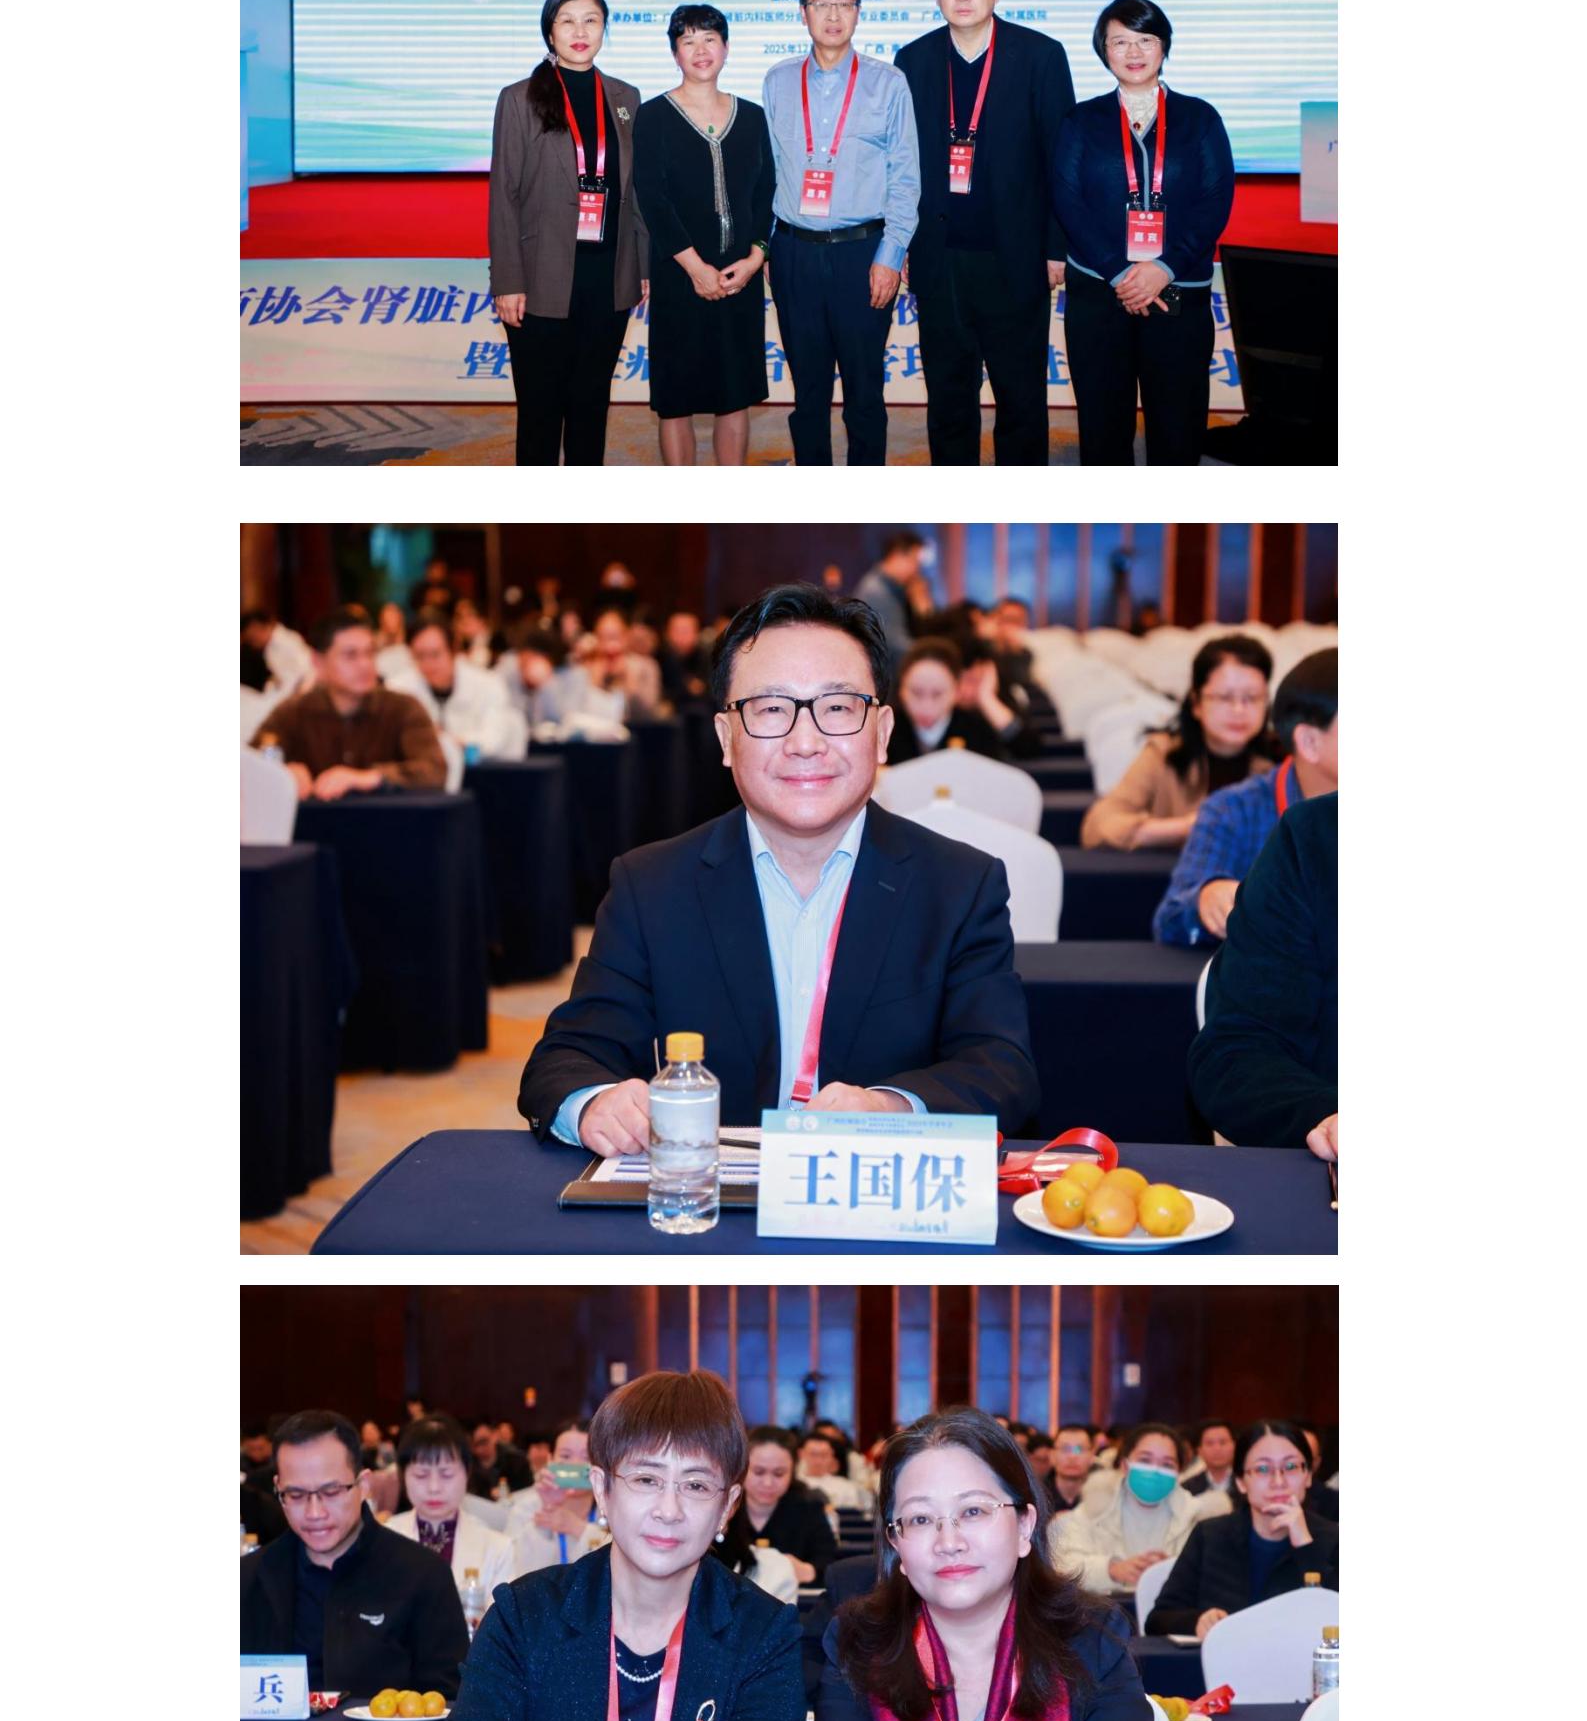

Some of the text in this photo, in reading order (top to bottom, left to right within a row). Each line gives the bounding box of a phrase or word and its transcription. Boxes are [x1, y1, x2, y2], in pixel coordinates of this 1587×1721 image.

[783, 1149, 968, 1214] 王国保
[253, 1673, 284, 1704] 兵
